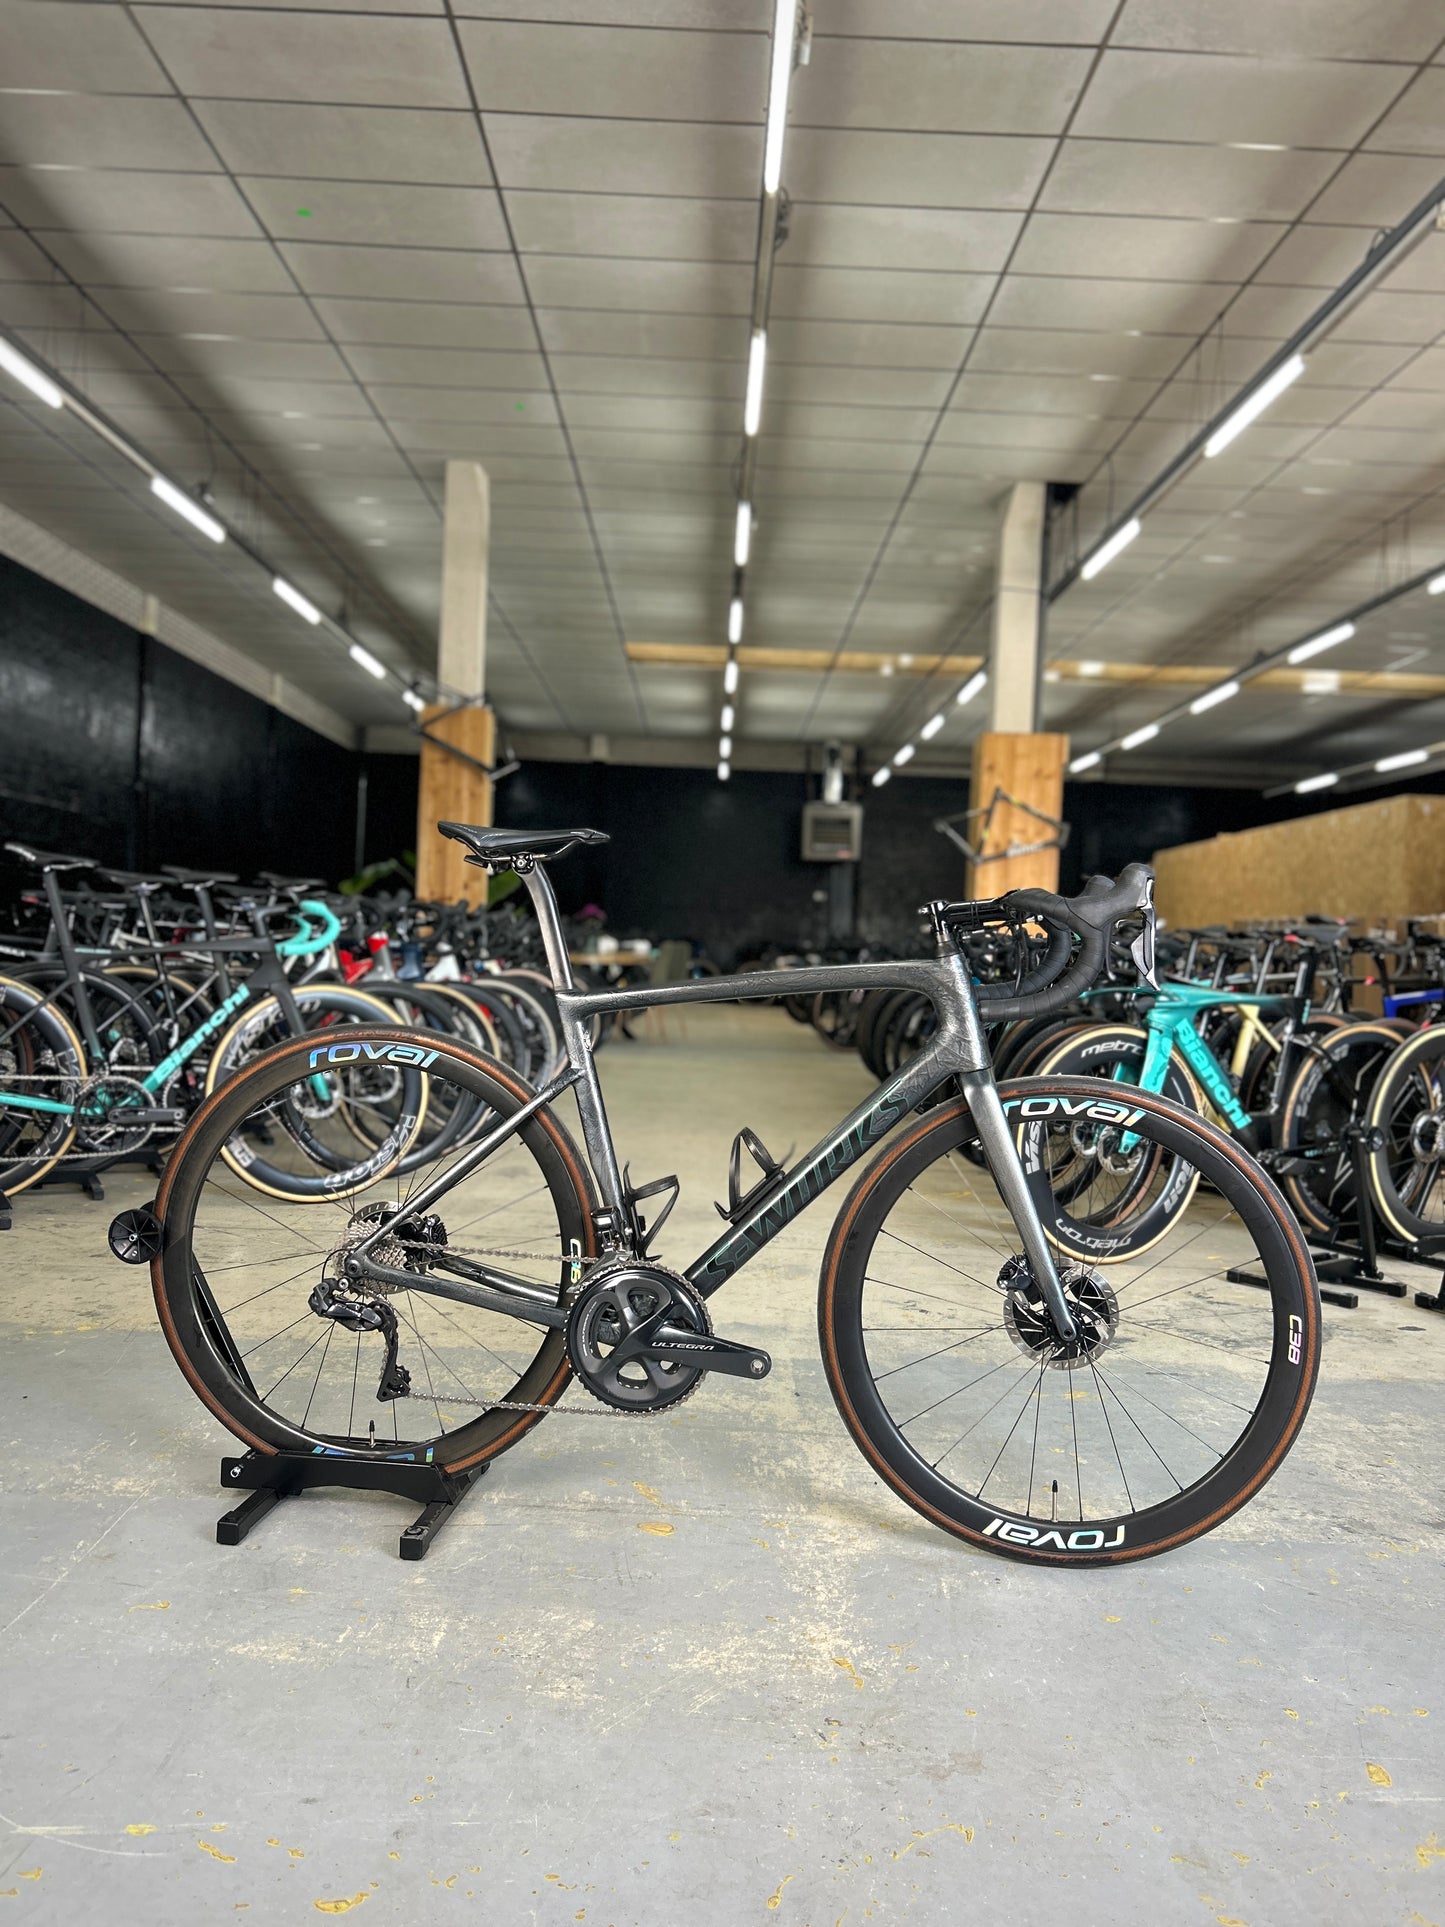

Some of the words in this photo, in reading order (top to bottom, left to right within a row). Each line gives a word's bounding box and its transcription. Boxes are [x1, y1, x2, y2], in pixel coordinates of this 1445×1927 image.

[153, 982, 251, 1085] Bianchi
[309, 1043, 440, 1069] roval
[1175, 1017, 1253, 1130] Bianchi
[1002, 1098, 1147, 1127] roval
[1056, 1218, 1132, 1249] metron
[651, 1341, 715, 1351] ULTEGRA
[1288, 1314, 1303, 1365] C38
[982, 1518, 1126, 1550] roval
